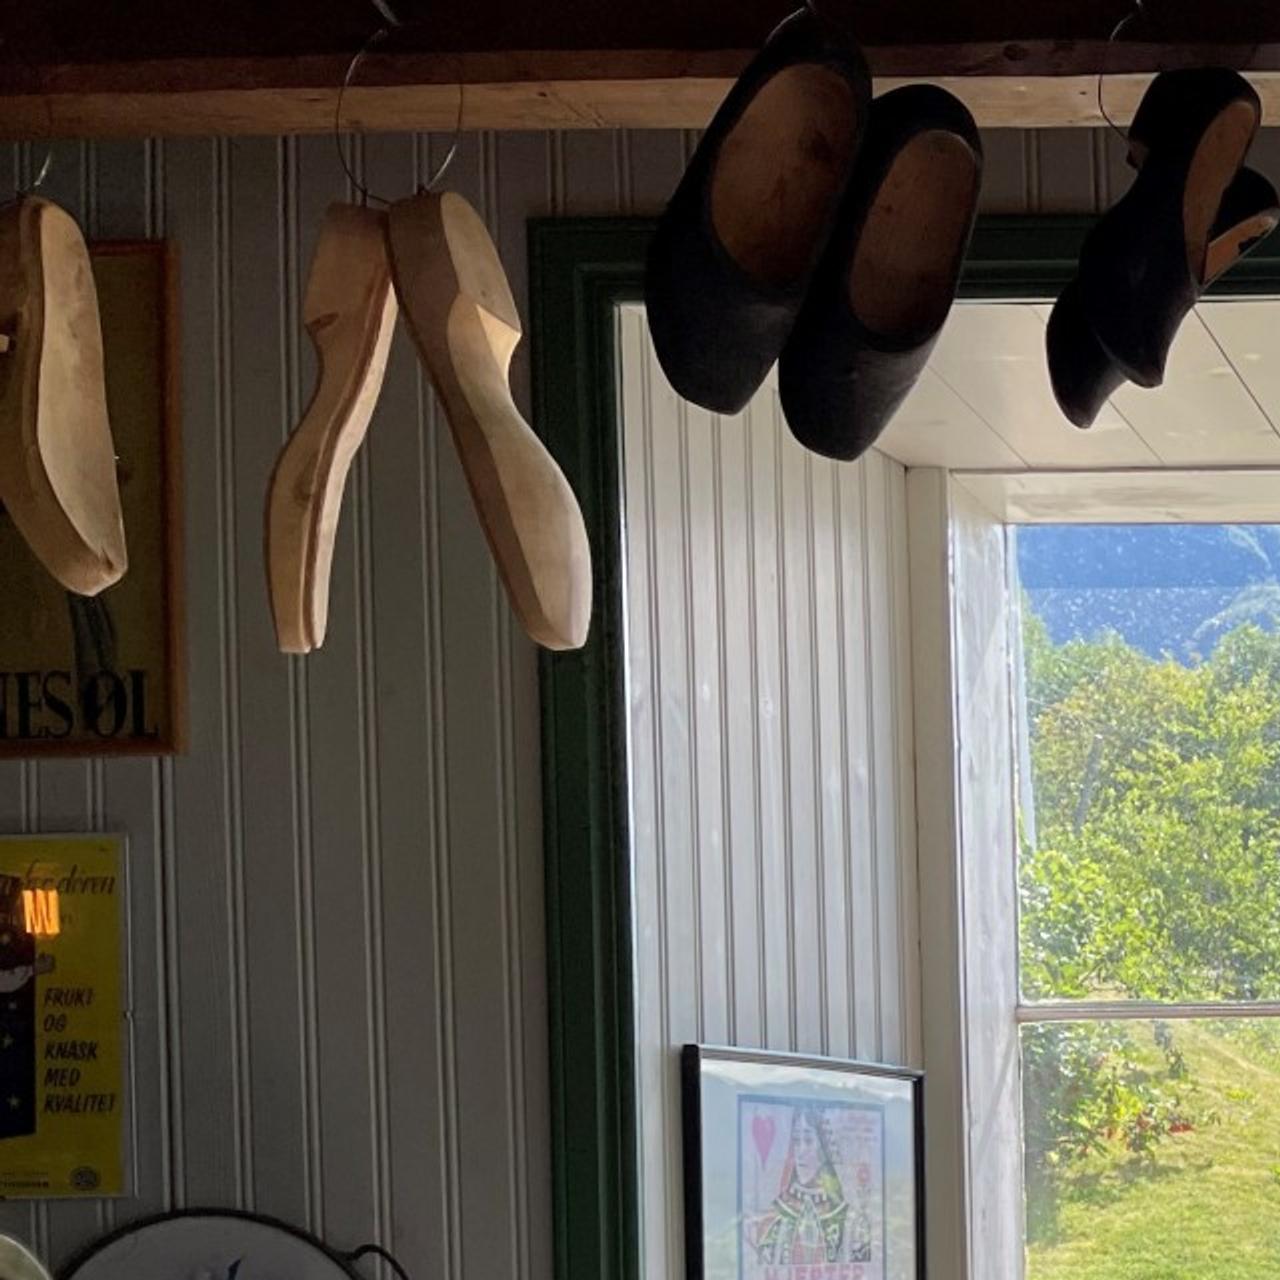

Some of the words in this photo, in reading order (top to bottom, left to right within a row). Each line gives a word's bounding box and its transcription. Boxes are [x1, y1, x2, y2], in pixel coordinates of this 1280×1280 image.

[43, 987, 94, 1008] FRUKT
[43, 1013, 67, 1033] OG
[43, 1039, 98, 1060] KNASK
[43, 1067, 81, 1087] MED
[43, 1093, 116, 1114] KVALITET
